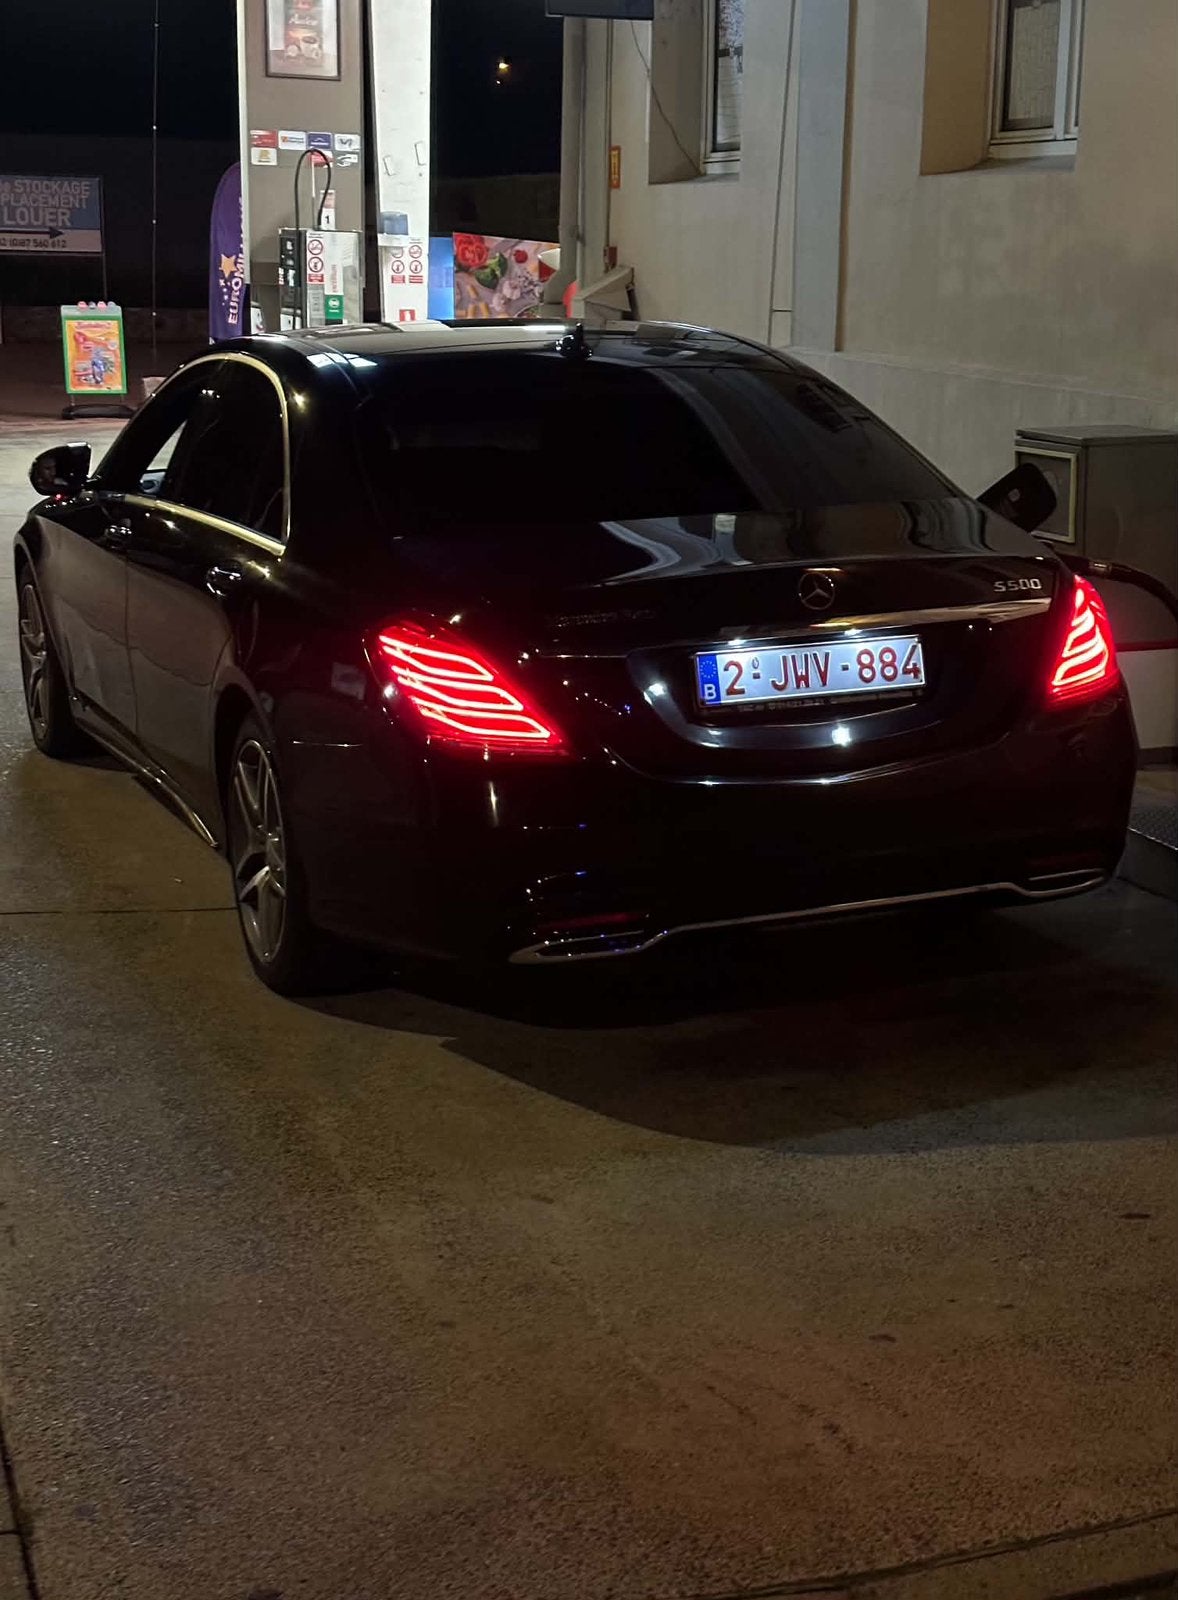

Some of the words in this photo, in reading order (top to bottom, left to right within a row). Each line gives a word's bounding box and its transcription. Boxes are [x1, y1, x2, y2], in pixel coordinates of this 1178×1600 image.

[14, 179, 90, 194] STOCKAGE
[4, 206, 72, 227] LOUER
[703, 684, 717, 700] B
